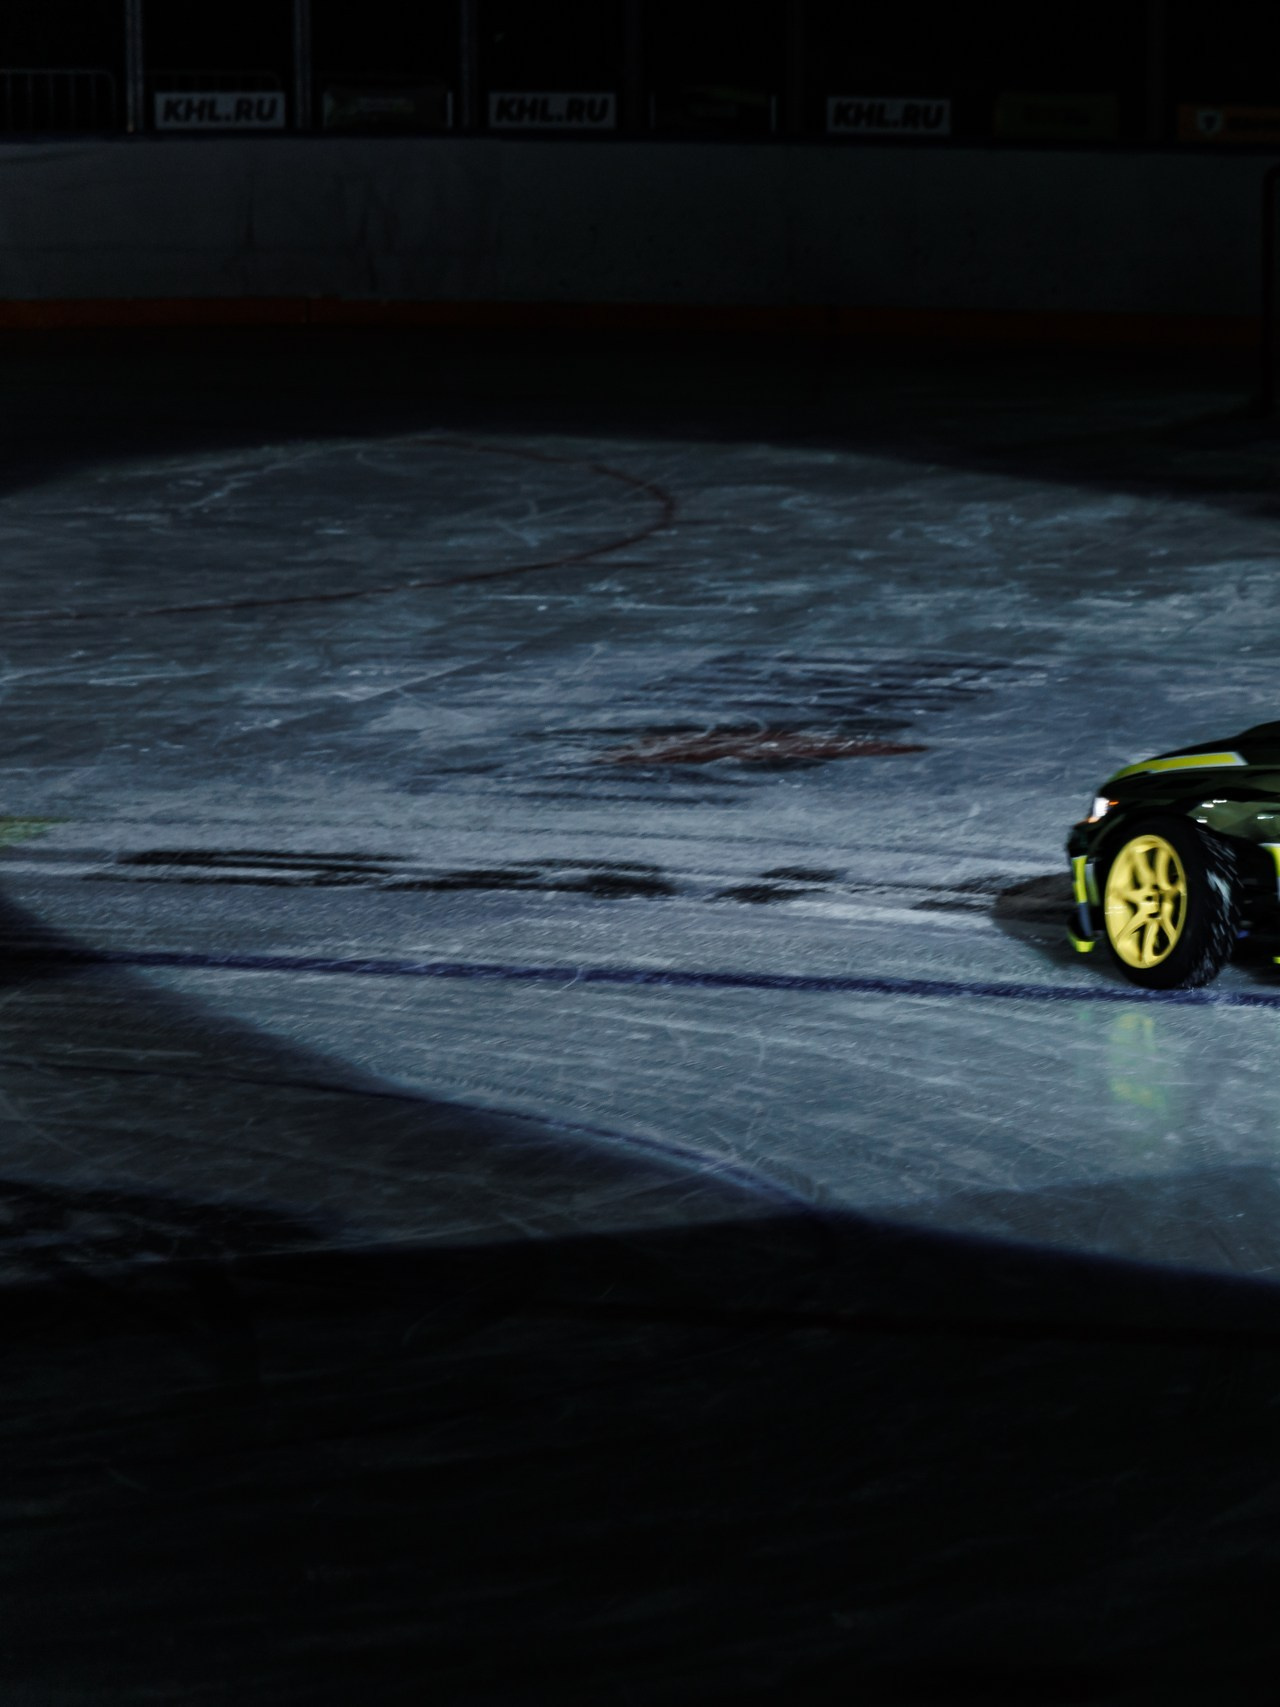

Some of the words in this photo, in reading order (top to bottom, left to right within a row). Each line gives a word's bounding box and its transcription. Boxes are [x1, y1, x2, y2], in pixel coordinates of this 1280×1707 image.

[163, 98, 278, 122] KHL.RU
[496, 98, 609, 122] KHL.RU
[832, 104, 944, 129] KHL.RU
